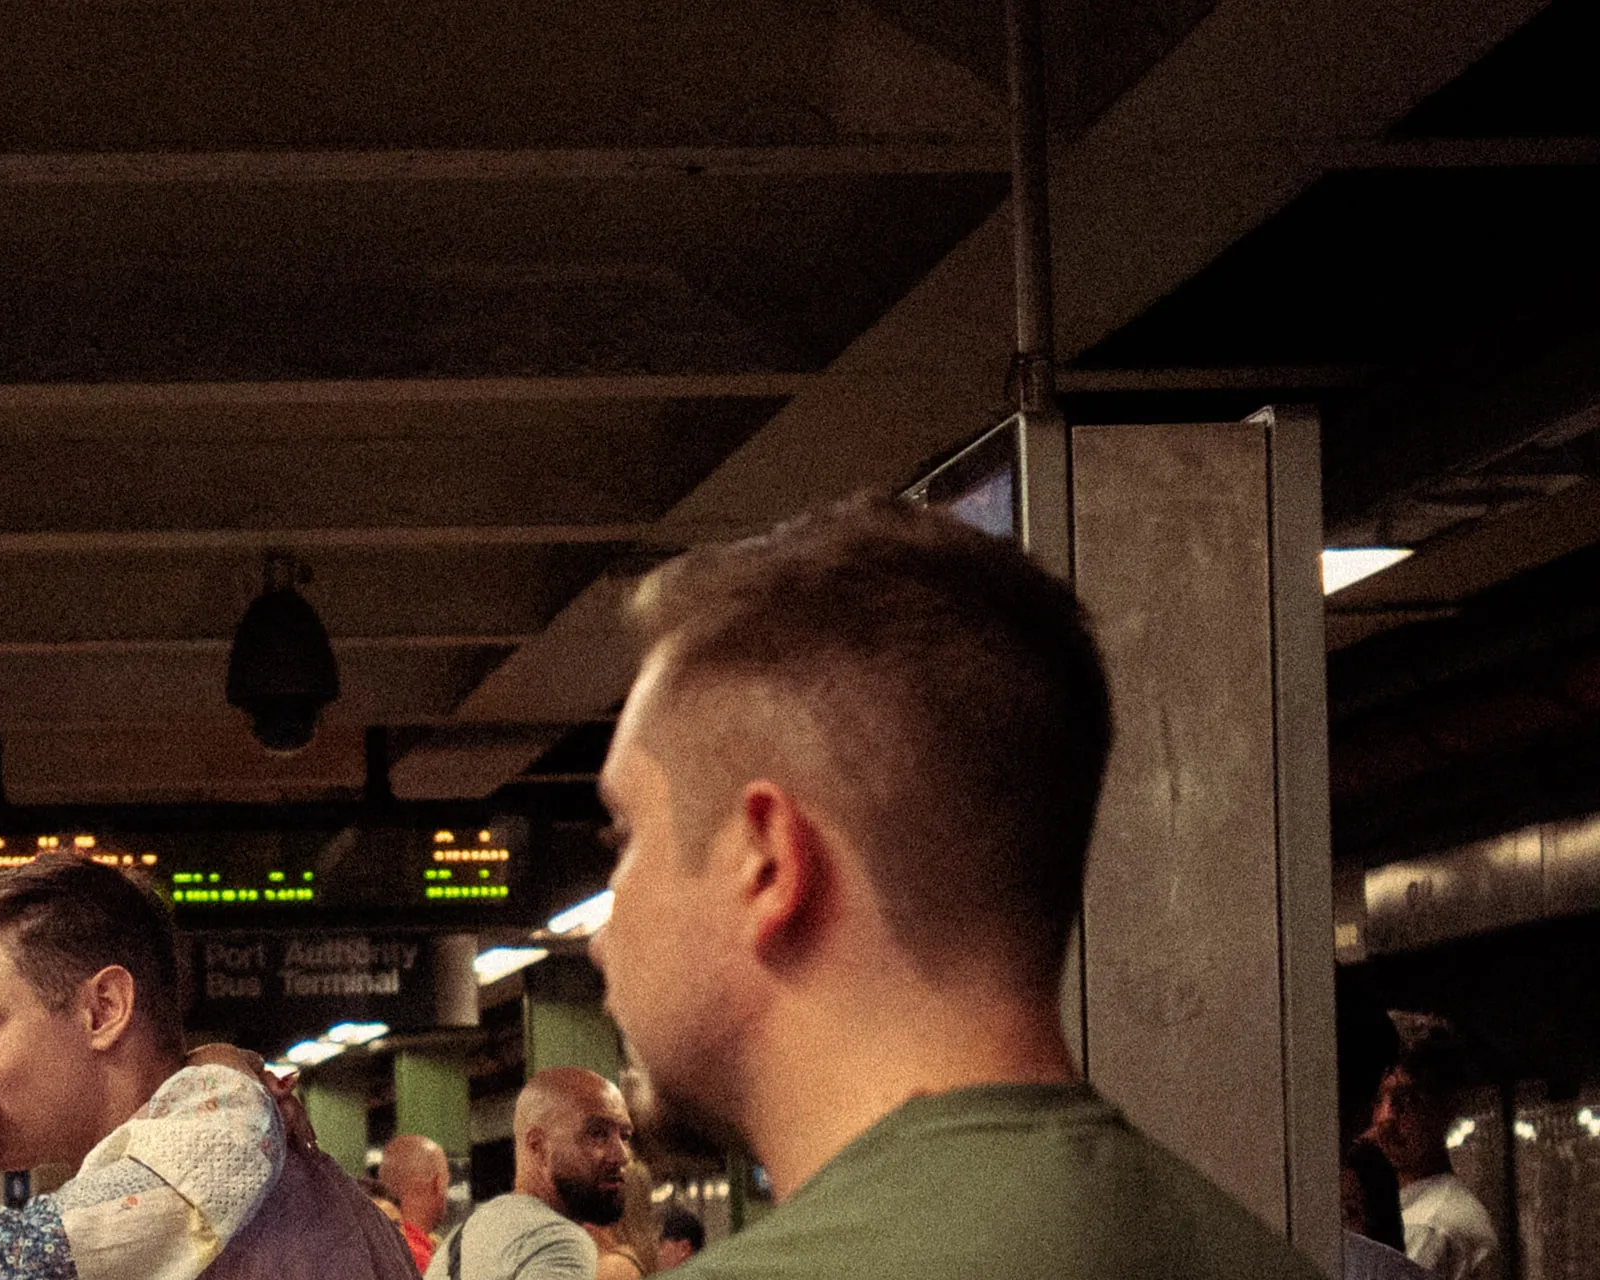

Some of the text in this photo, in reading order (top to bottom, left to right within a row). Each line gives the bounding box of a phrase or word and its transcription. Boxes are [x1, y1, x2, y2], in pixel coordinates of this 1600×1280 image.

[206, 944, 266, 968] Port
[207, 968, 399, 997] Bus Terminal
